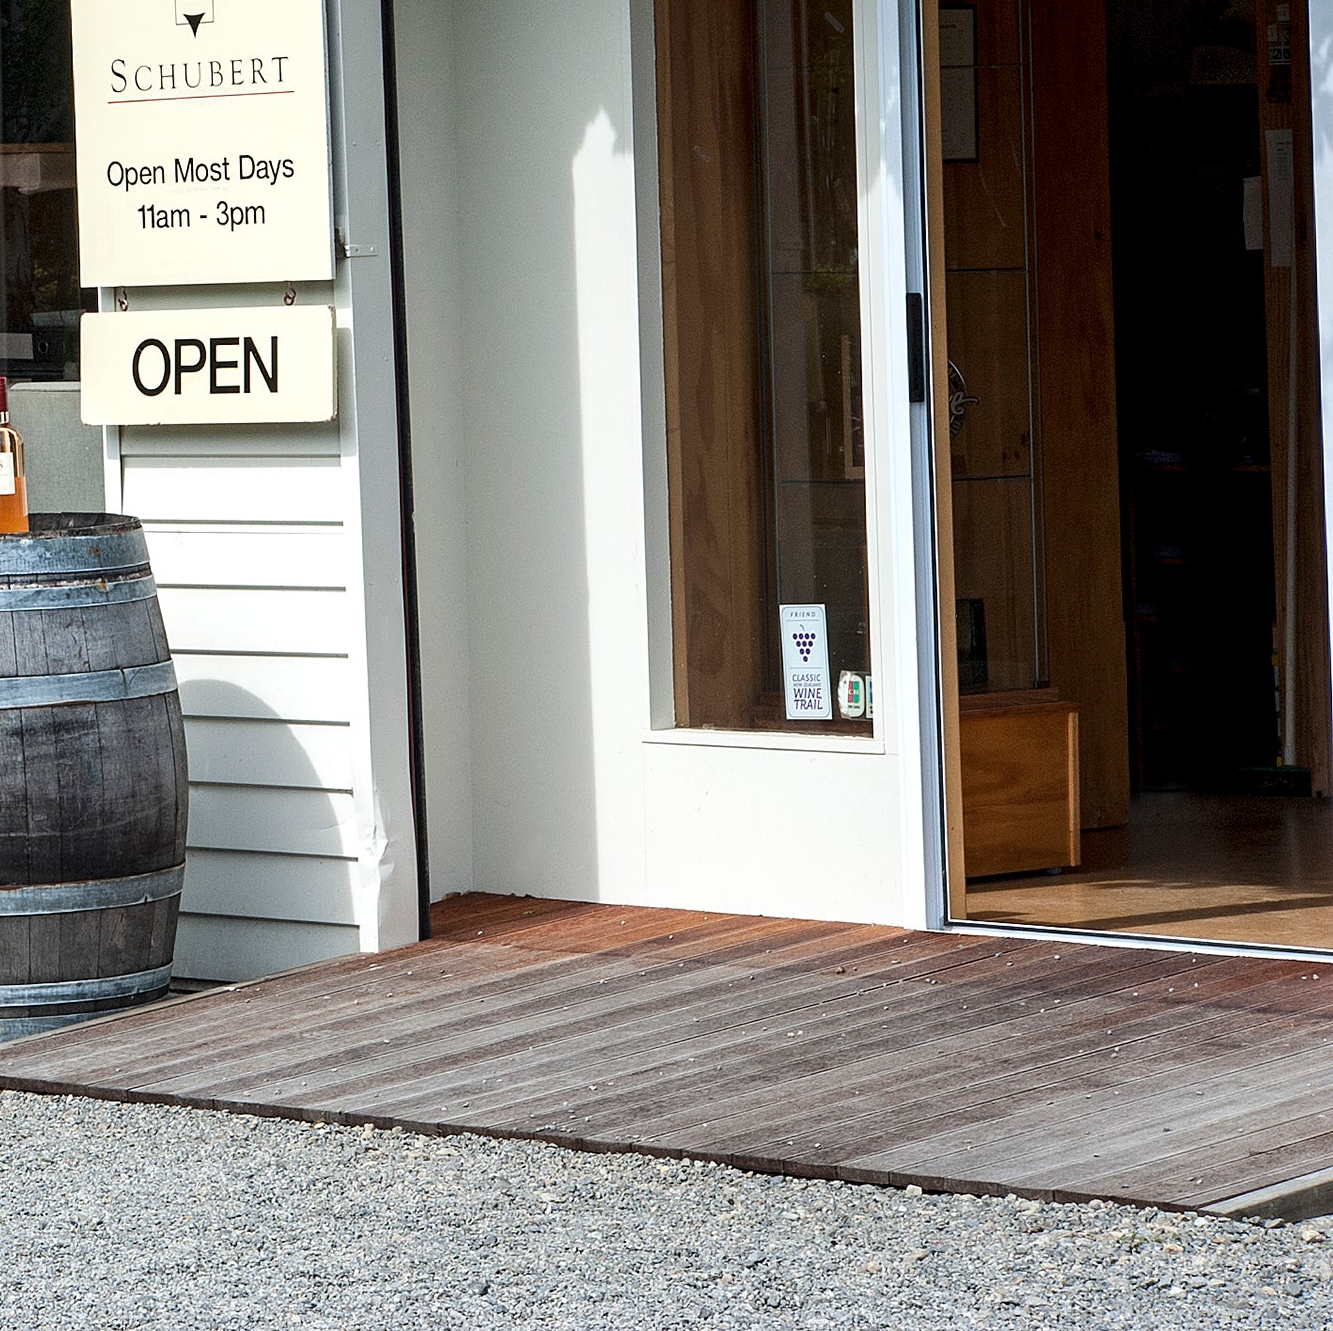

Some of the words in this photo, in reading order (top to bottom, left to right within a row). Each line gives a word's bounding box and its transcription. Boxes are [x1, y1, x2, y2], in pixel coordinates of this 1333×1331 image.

[110, 56, 290, 93] SCHUBERT
[107, 160, 166, 192] Open
[174, 157, 231, 184] Most
[238, 154, 295, 186] Days
[137, 203, 191, 230] 11am
[216, 200, 266, 231] 3pm
[132, 335, 279, 397] OPEN
[792, 673, 821, 682] CLASSIC
[793, 687, 822, 699] WINE
[794, 699, 823, 710] TRAIL
